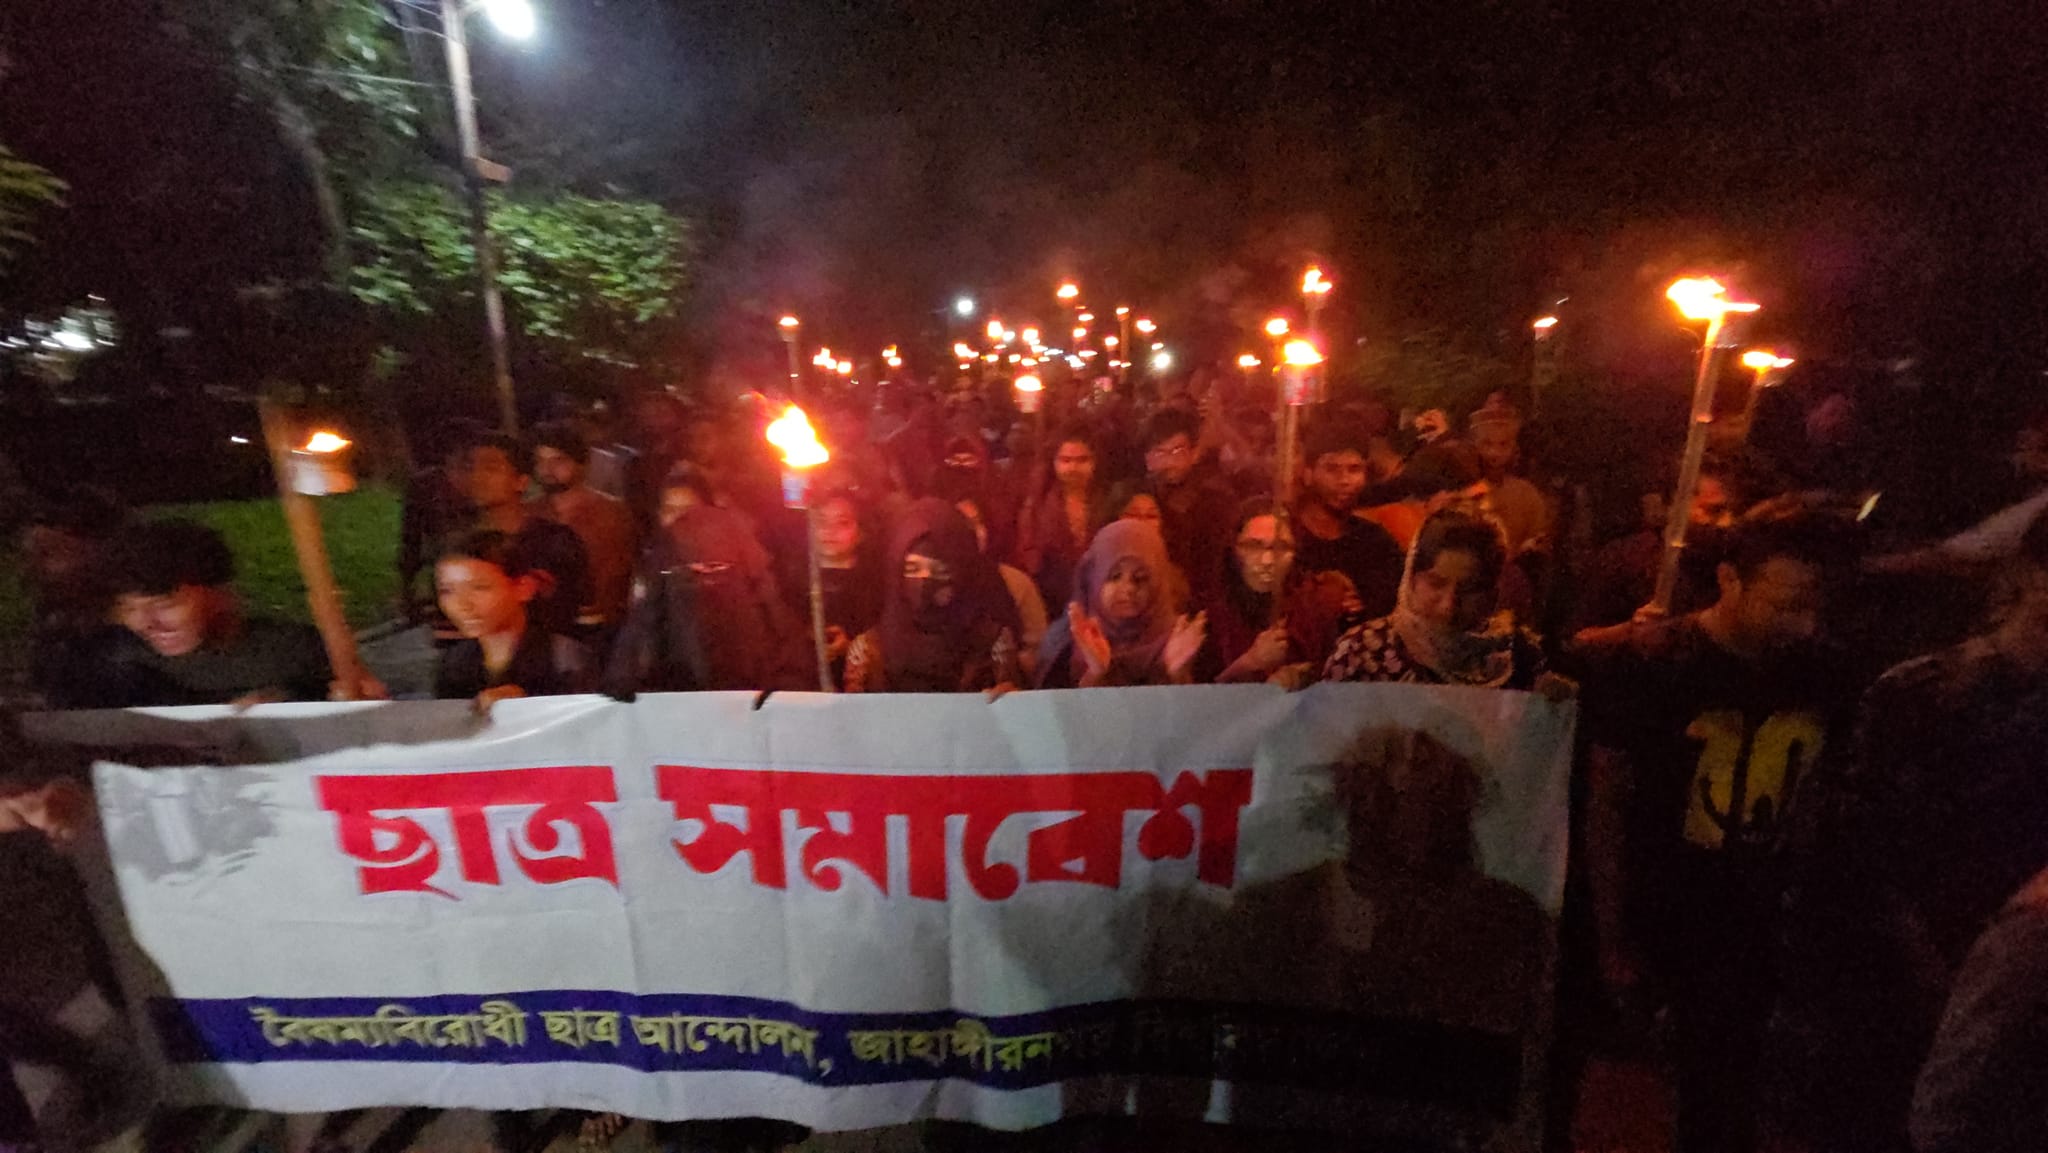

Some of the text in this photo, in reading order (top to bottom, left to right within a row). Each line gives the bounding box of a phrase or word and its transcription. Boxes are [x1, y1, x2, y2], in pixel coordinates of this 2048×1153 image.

[316, 765, 1252, 901] ছাত্র সমাবেশ
[248, 1000, 529, 1048] বৈষম্যবিরোধী
[538, 1008, 622, 1049] ছাত্র
[629, 1011, 833, 1077] আন্দোলন,
